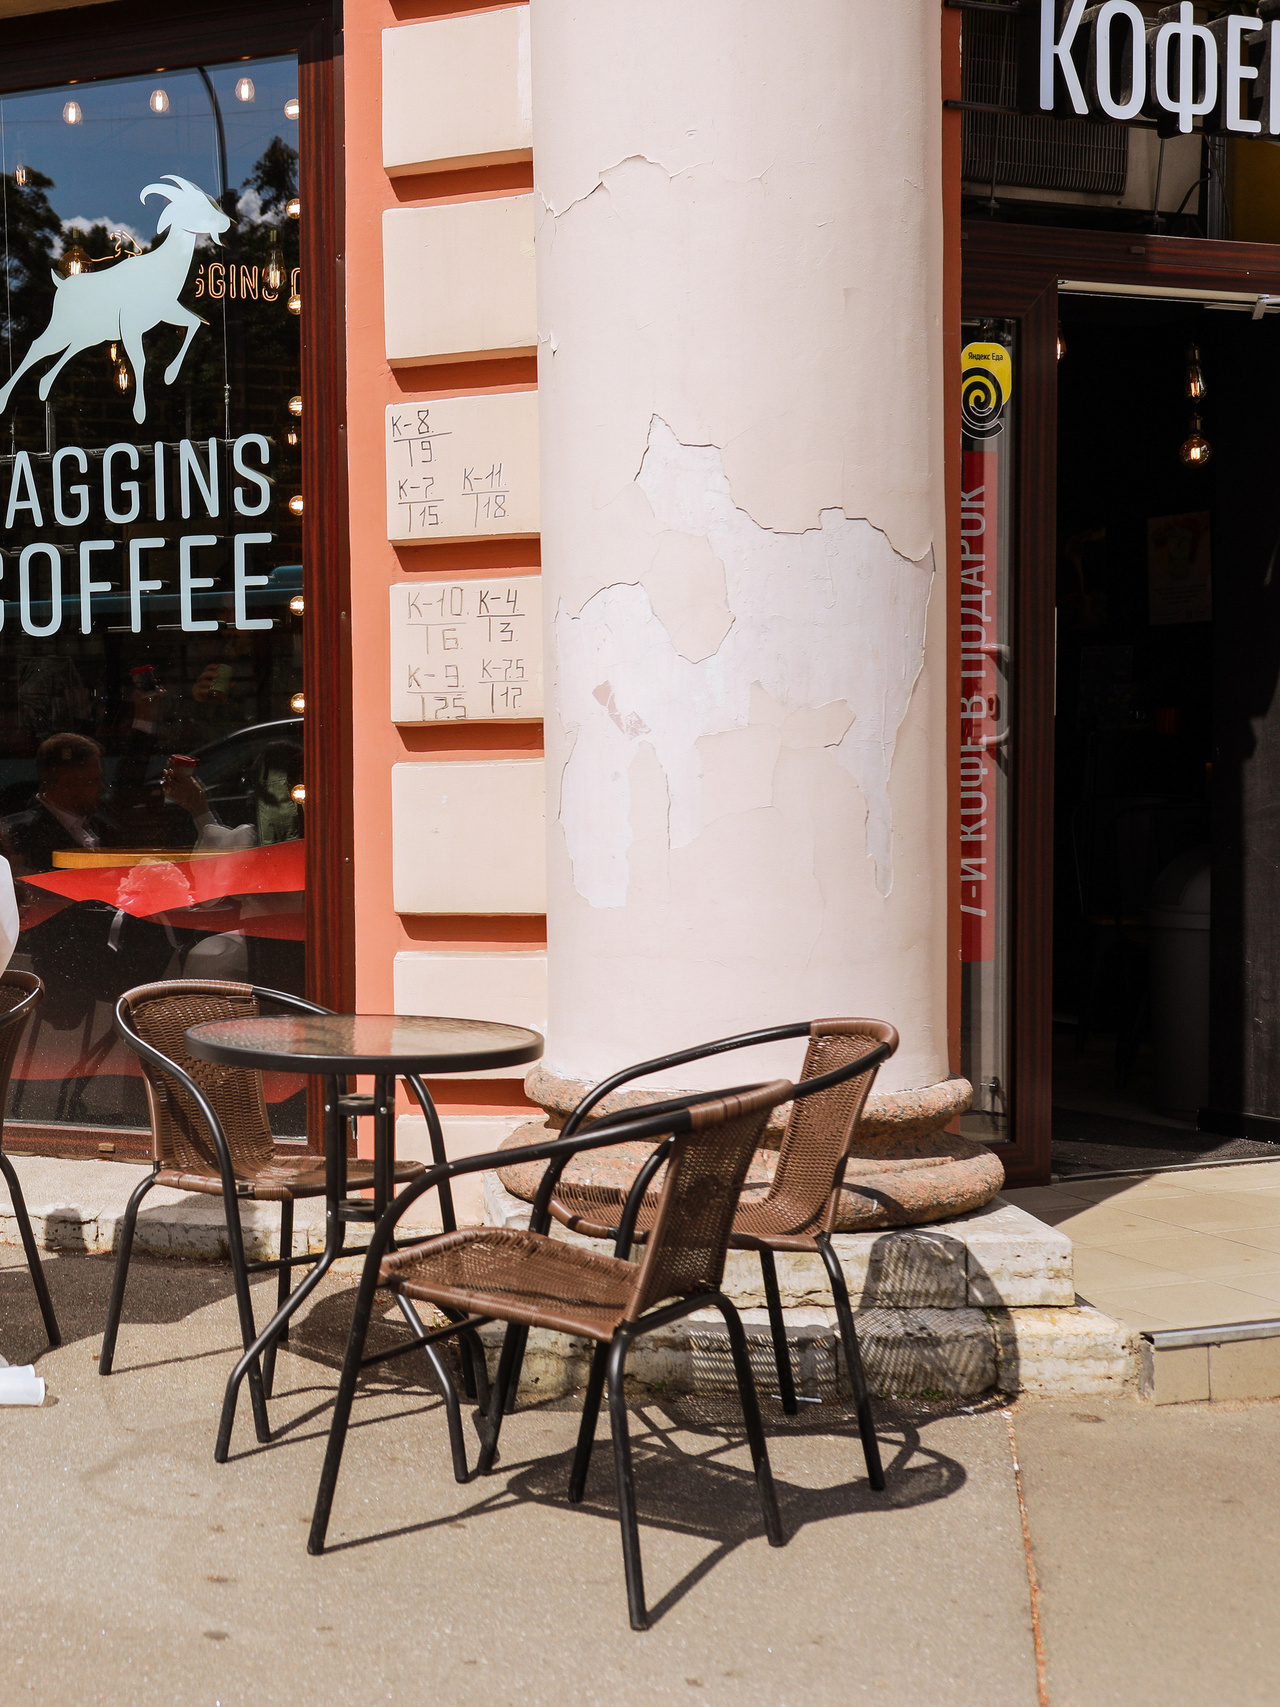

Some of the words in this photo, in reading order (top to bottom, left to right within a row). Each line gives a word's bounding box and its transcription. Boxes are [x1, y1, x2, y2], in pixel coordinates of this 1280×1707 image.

[1039, 0, 1280, 134] КОФЕ
[968, 352, 991, 361] Яндекс
[992, 352, 1004, 361] Еда
